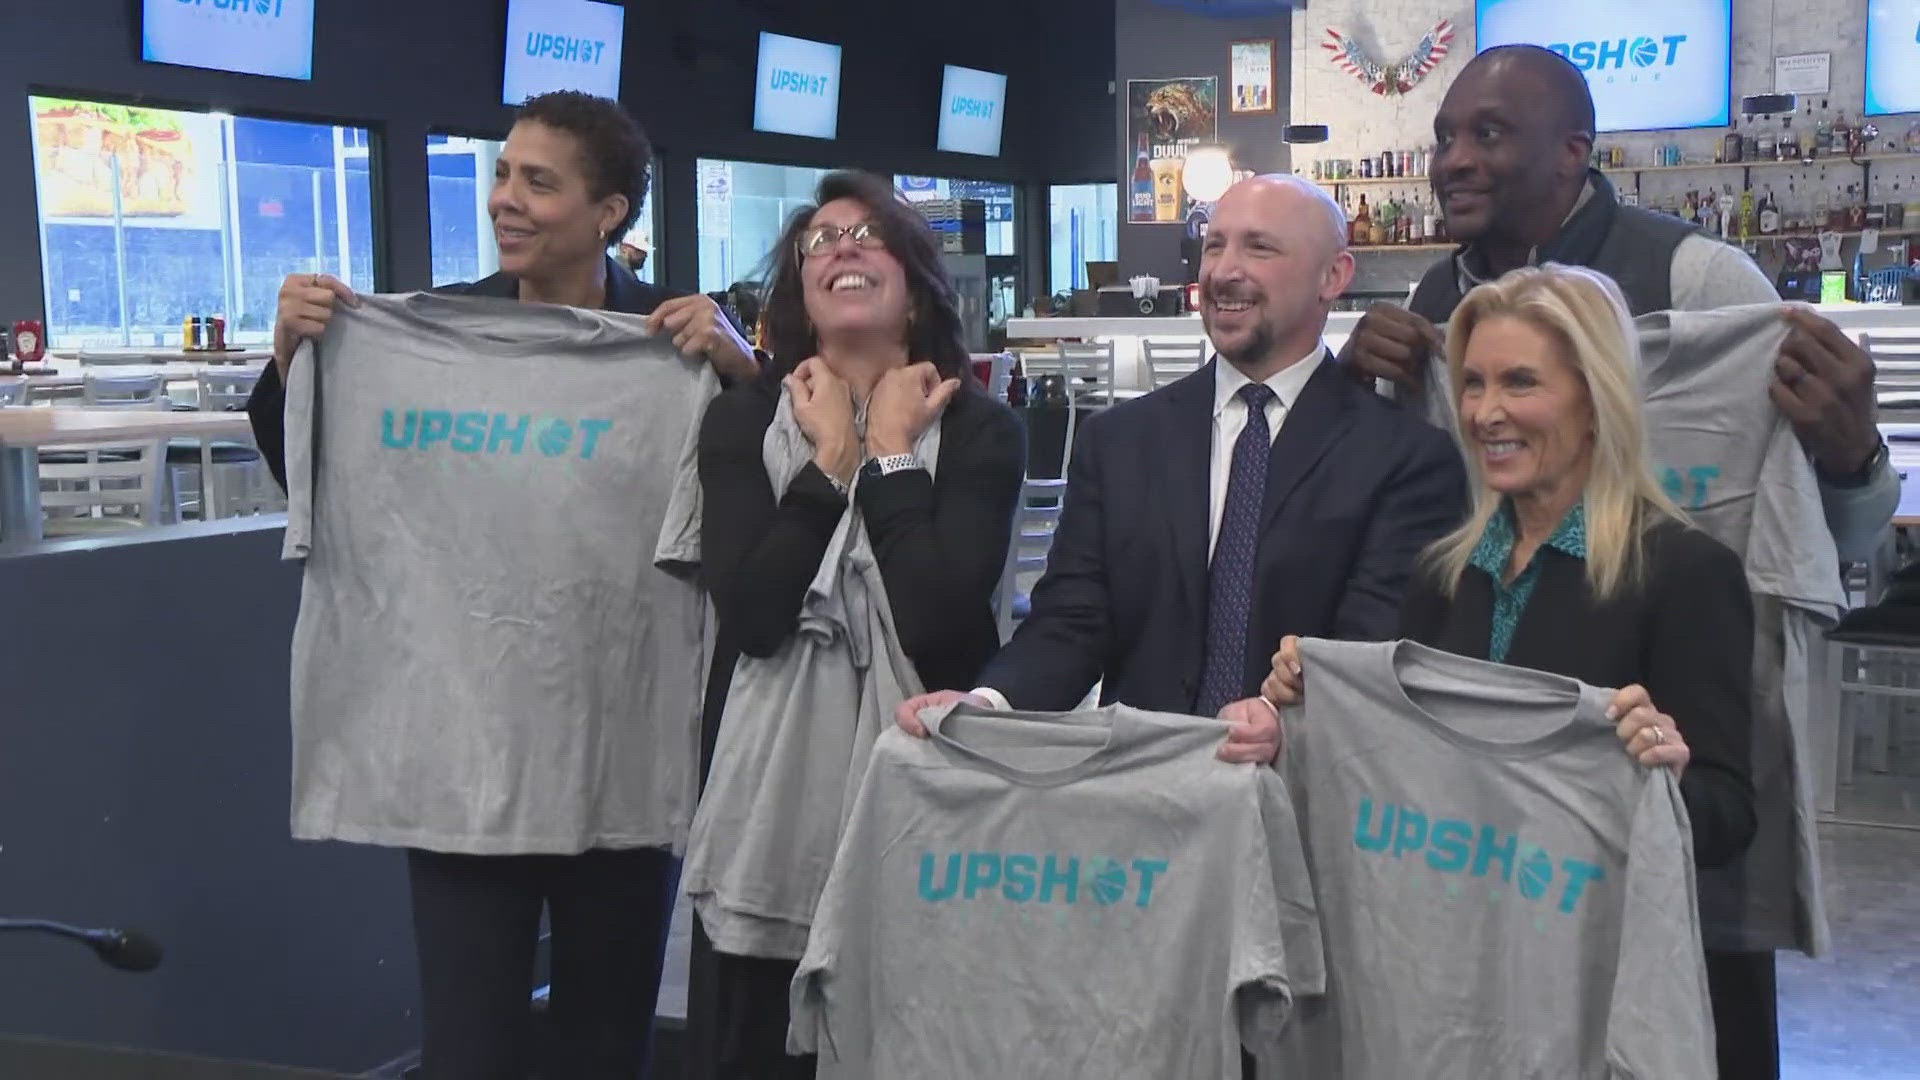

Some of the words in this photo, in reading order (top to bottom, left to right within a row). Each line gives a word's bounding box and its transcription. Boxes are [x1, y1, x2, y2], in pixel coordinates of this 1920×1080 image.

[526, 32, 605, 65] UPSHOT
[770, 68, 828, 96] UPSHOT
[381, 408, 613, 459] UPSHOT
[918, 852, 1169, 909] UPSHOT
[1354, 796, 1606, 914] UPSHOT
